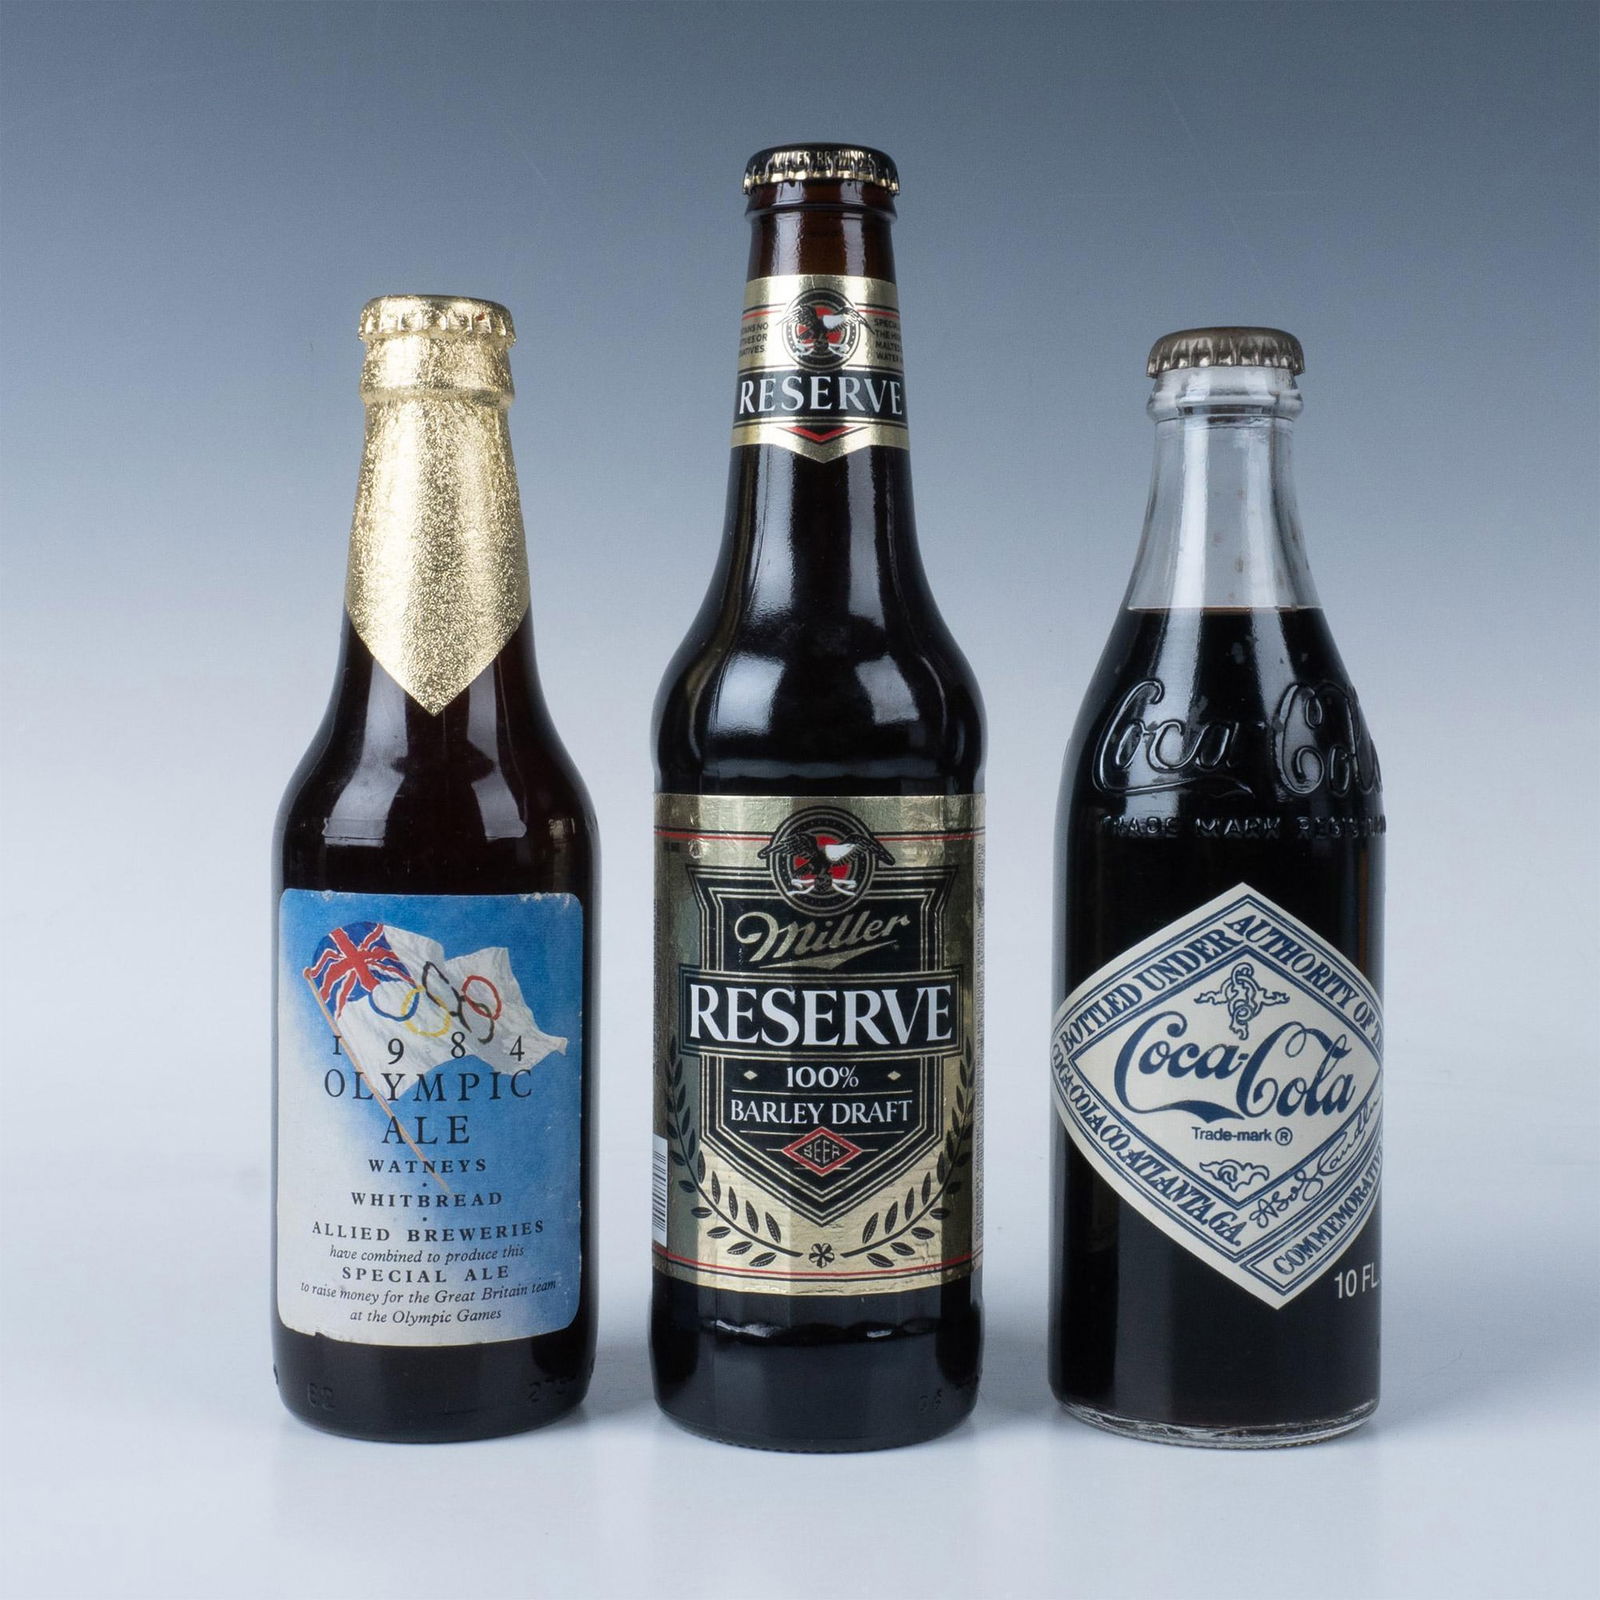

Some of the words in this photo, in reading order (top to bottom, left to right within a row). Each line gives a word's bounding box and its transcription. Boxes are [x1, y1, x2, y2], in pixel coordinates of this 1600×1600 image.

[739, 375, 903, 415] RESERVE
[734, 910, 911, 963] Miller
[1060, 983, 1143, 1055] BOTTLED
[1134, 928, 1244, 992] UNDER
[1224, 915, 1359, 1010] AUTHORITY
[690, 984, 953, 1046] RESERVE
[786, 1065, 859, 1089] 100%
[1114, 1011, 1357, 1124] Coca-Cola
[324, 1069, 532, 1101] OLYMPIC
[731, 1099, 824, 1124] BARLEY
[832, 1100, 912, 1125] DRAFT
[382, 1115, 470, 1145] ALE
[1191, 1126, 1272, 1142] Trade-mark
[368, 1158, 487, 1174] WATNEYS
[351, 1191, 503, 1208] WHITBREAD
[312, 1221, 390, 1242] ALLIED
[407, 1219, 544, 1242] BREWERIES
[329, 1245, 357, 1260] have
[361, 1248, 422, 1264] combined
[428, 1250, 440, 1263] to
[445, 1246, 498, 1266] produce
[502, 1243, 525, 1258] this
[342, 1266, 447, 1283] SPECIAL
[464, 1265, 509, 1282] ALE
[1334, 1268, 1357, 1299] 10
[301, 1281, 310, 1293] to
[312, 1283, 337, 1298] raise
[340, 1287, 379, 1305] money
[382, 1289, 403, 1305] for
[409, 1290, 429, 1304] the
[434, 1289, 476, 1304] Great
[481, 1286, 528, 1301] Britain
[532, 1280, 557, 1295] team
[350, 1310, 362, 1322] at
[367, 1309, 387, 1323] the
[392, 1309, 452, 1327] Olympic
[457, 1309, 502, 1323] Games
